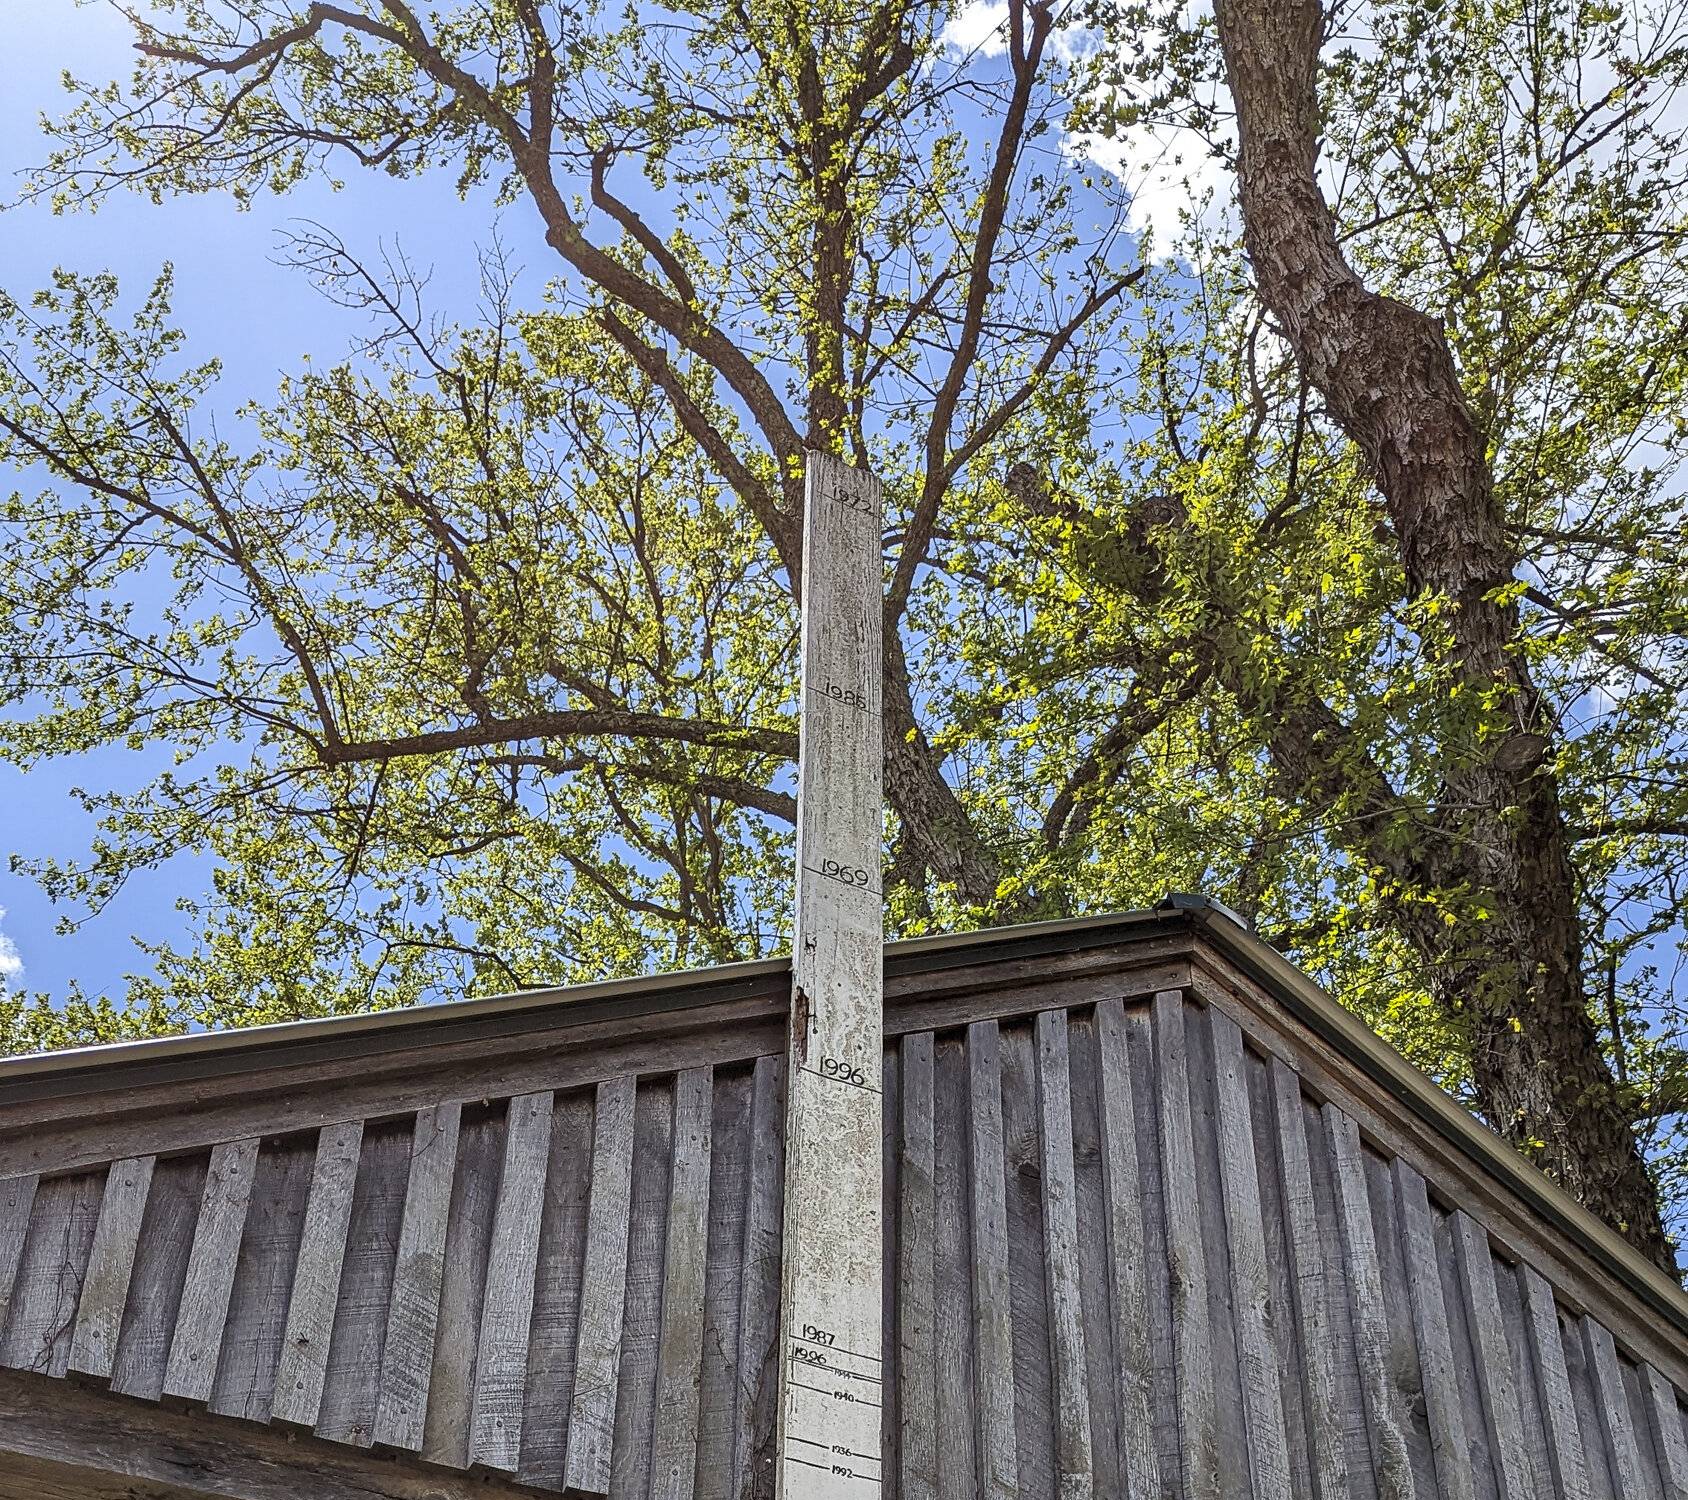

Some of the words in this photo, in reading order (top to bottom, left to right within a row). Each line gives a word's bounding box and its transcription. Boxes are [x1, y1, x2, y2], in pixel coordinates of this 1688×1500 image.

[822, 858, 868, 886] 1969
[819, 1056, 865, 1085] 1996
[803, 1324, 835, 1345] 1987
[833, 1391, 855, 1403] 1940
[831, 1445, 852, 1457] 1936
[831, 1464, 853, 1479] 1992
